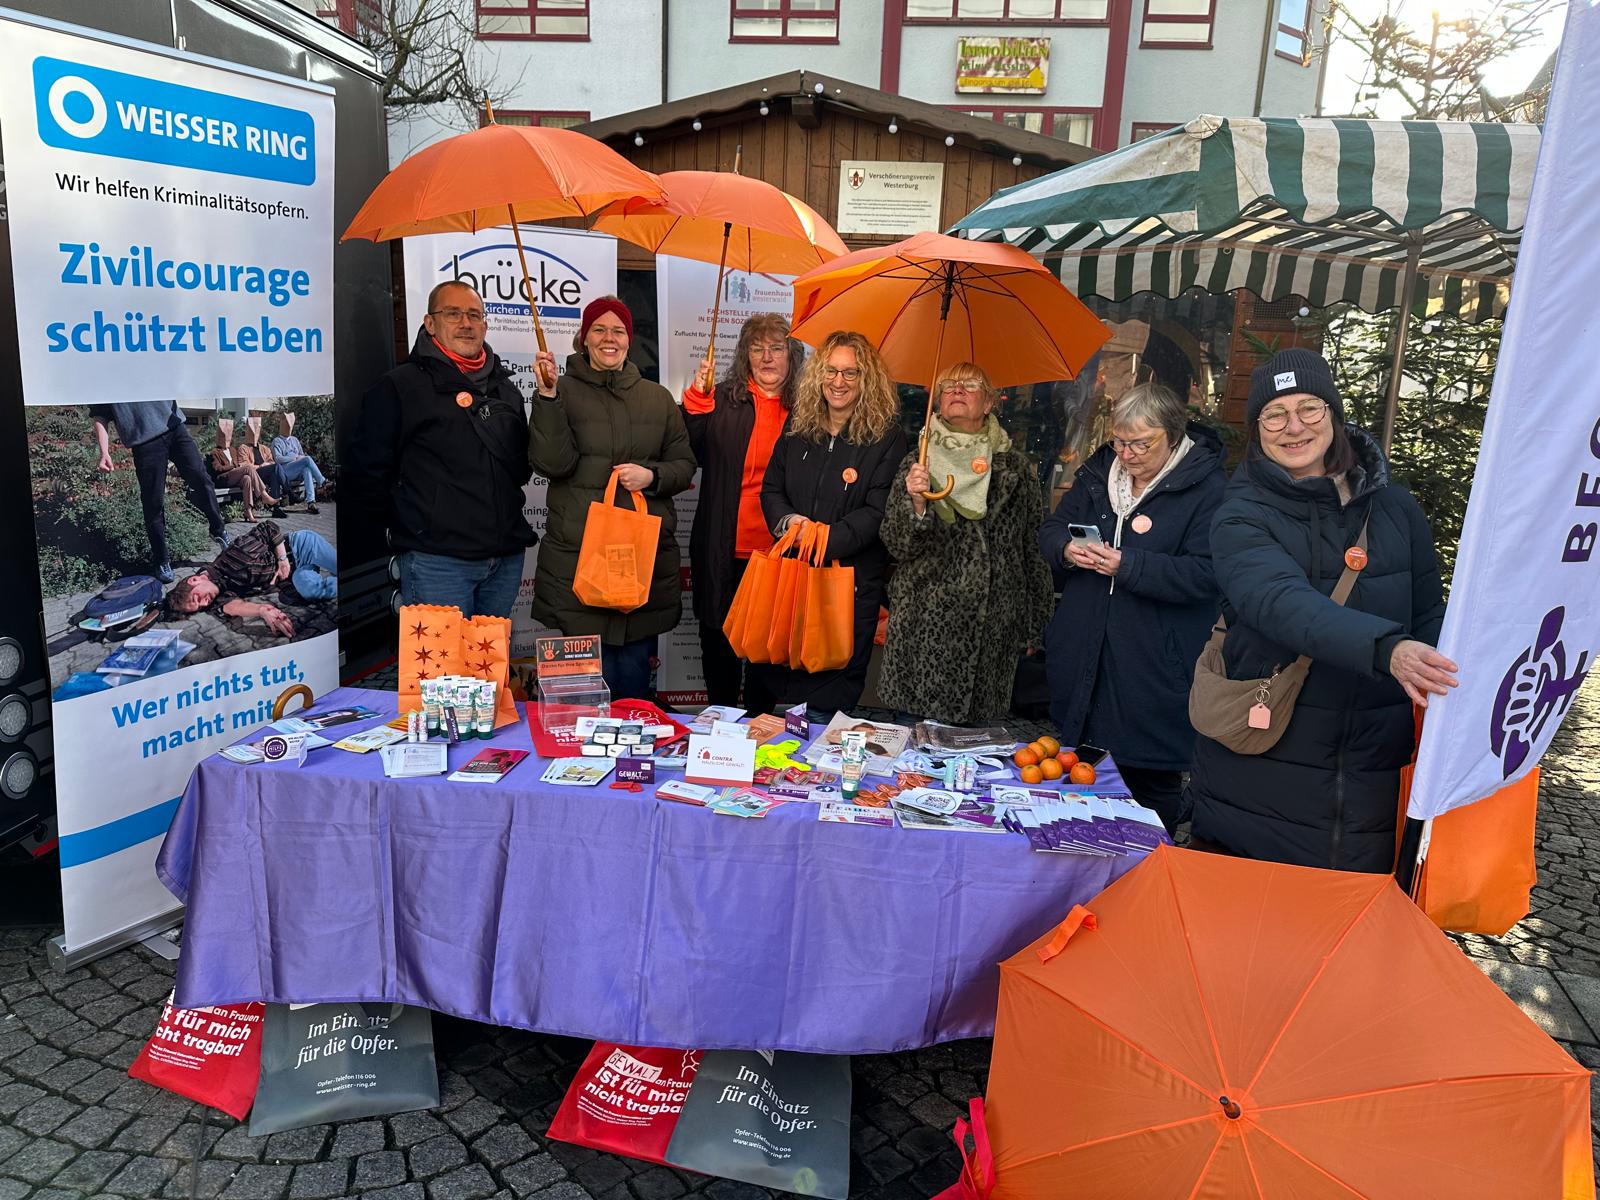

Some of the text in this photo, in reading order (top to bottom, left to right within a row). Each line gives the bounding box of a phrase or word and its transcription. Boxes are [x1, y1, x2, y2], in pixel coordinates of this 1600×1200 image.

[116, 100, 307, 161] WEISSER RING
[869, 173, 935, 181] Verschönerungsverein
[884, 182, 919, 190] Westerburg
[55, 173, 309, 219] Wir helfen Kriminalitätsopfern.
[59, 243, 310, 306] Zivilcourage
[453, 255, 581, 305] brücke
[485, 304, 520, 315] kirchen
[707, 309, 750, 317] FAHSTELLE
[46, 311, 322, 353] schützt Leben
[524, 507, 548, 518] ining
[564, 640, 592, 653] STOPP
[112, 659, 305, 728] Wer nichts tut,
[667, 692, 709, 702] www.fra
[142, 702, 274, 758] macht mit
[173, 1009, 206, 1031] für
[207, 1021, 251, 1041] mich
[213, 1007, 260, 1023] an Frauen
[307, 1012, 389, 1039] Im Einatz
[155, 1026, 181, 1043] cht
[183, 1032, 244, 1057] tragbar!
[294, 1034, 399, 1069] für die Opfer.
[317, 1074, 354, 1088] Opfer-Telefon
[595, 1067, 621, 1087] ist
[622, 1076, 648, 1098] für
[607, 1052, 660, 1080] GEWALT
[655, 1078, 666, 1087] an
[316, 1080, 377, 1095] www.weisser-ring.de
[585, 1081, 623, 1107] nicht
[625, 1098, 684, 1115] tragba
[736, 1065, 810, 1115] Im Einsatz
[716, 1085, 818, 1134] für die Opfer.
[732, 1138, 791, 1159] www.weisser-ring.de
[735, 1128, 771, 1147] Opfer-Telefon
